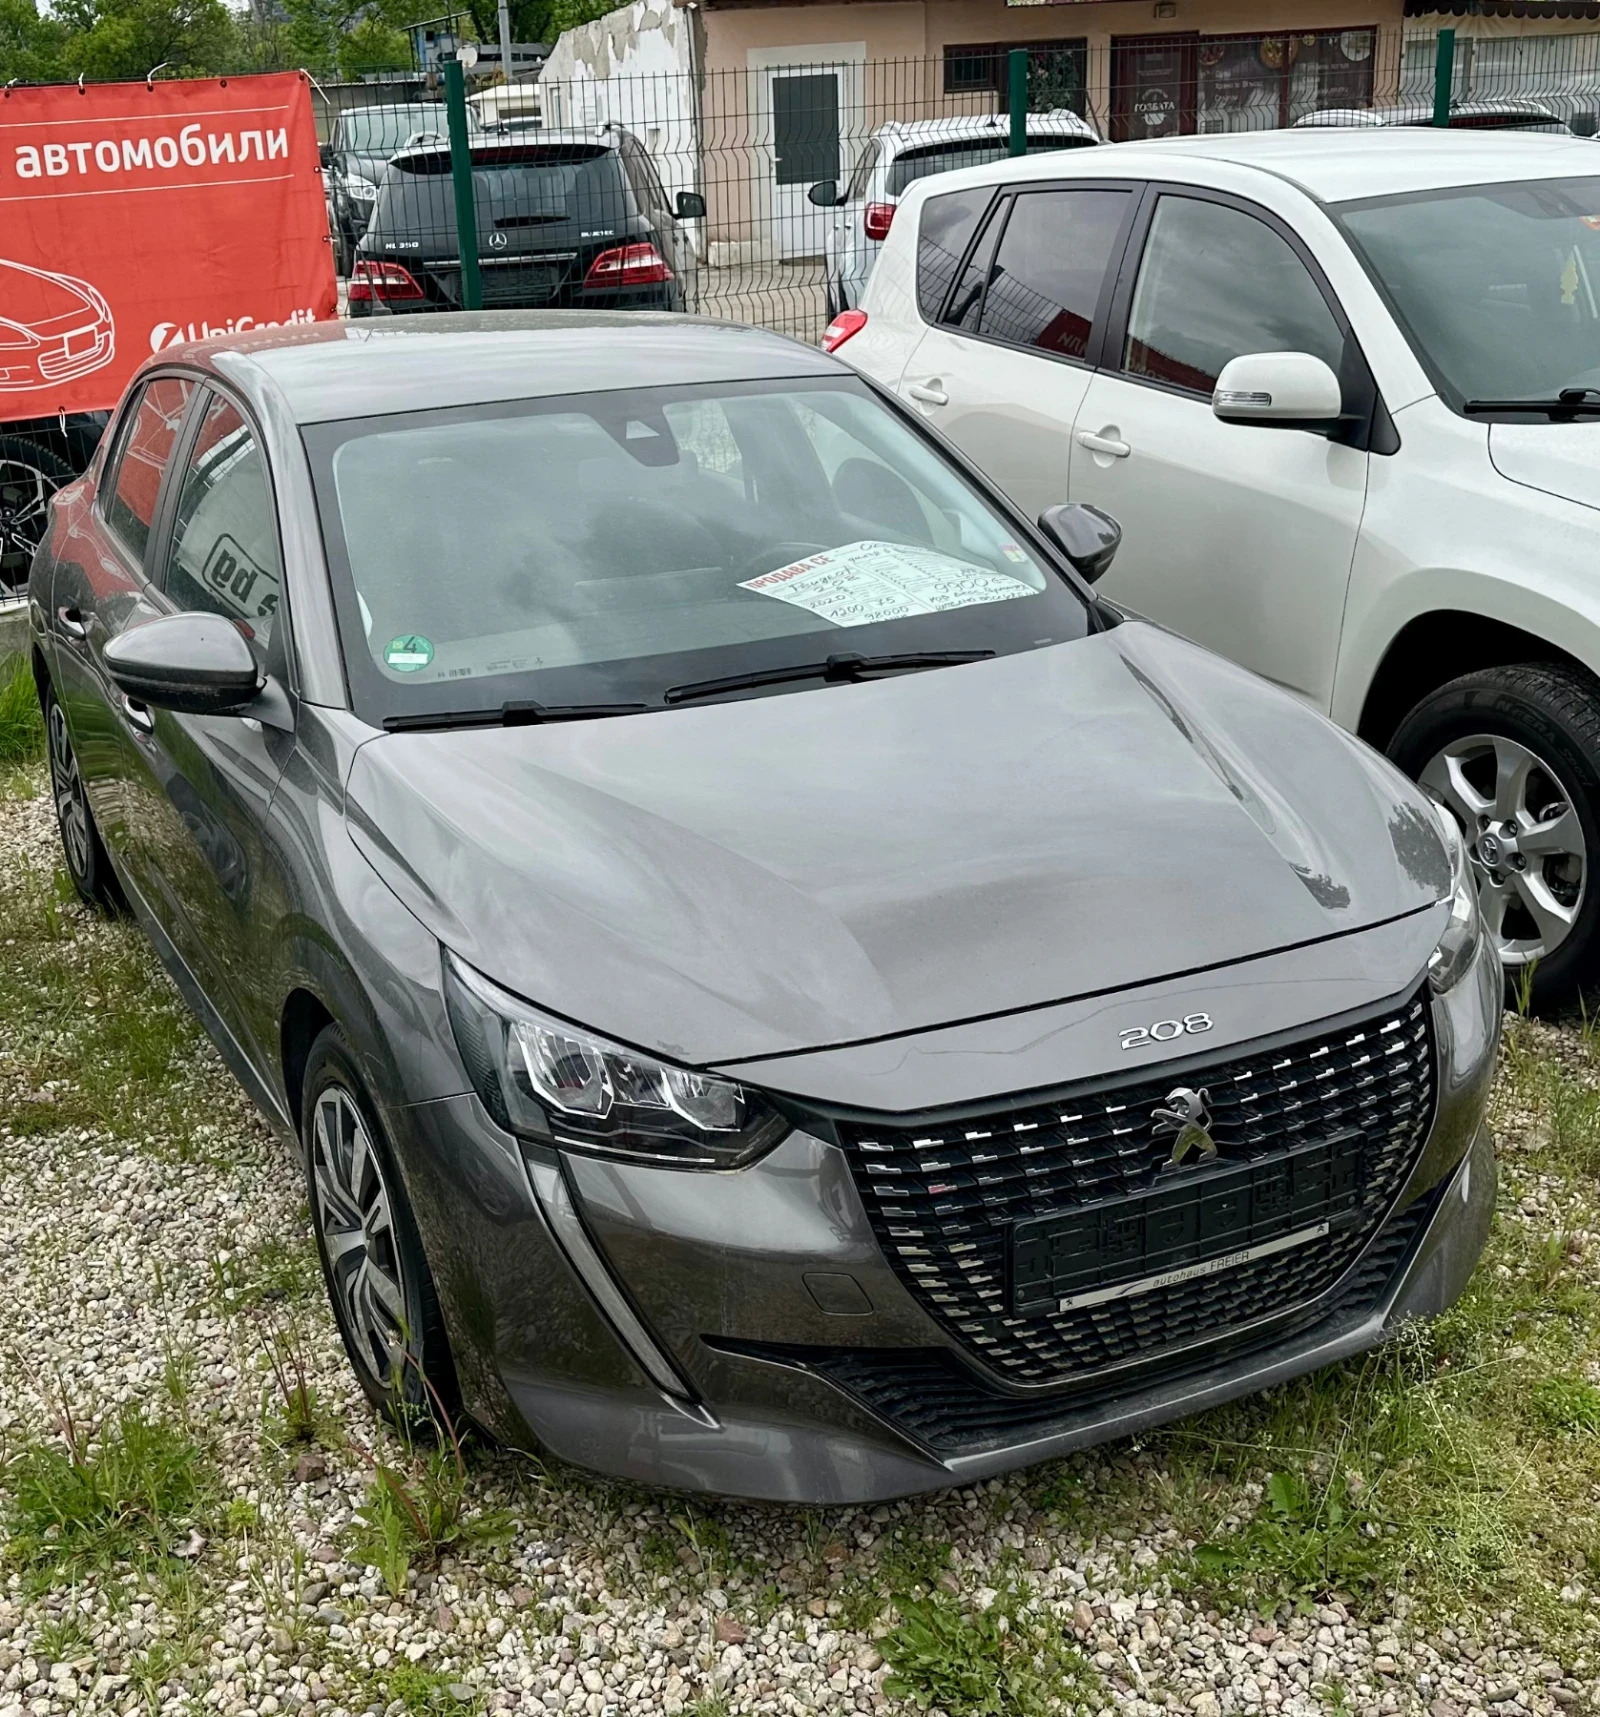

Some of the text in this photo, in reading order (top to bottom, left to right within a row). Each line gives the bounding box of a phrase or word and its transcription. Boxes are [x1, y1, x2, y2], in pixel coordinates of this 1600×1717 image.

[15, 123, 288, 179] автомобили
[746, 563, 816, 589] ПРОДАВА
[810, 555, 836, 566] СЕ
[934, 578, 988, 593] 9900
[831, 604, 864, 617] 1200
[403, 635, 417, 653] 4
[1118, 1012, 1214, 1050] 208
[1153, 1250, 1249, 1287] autohaus FREIER
